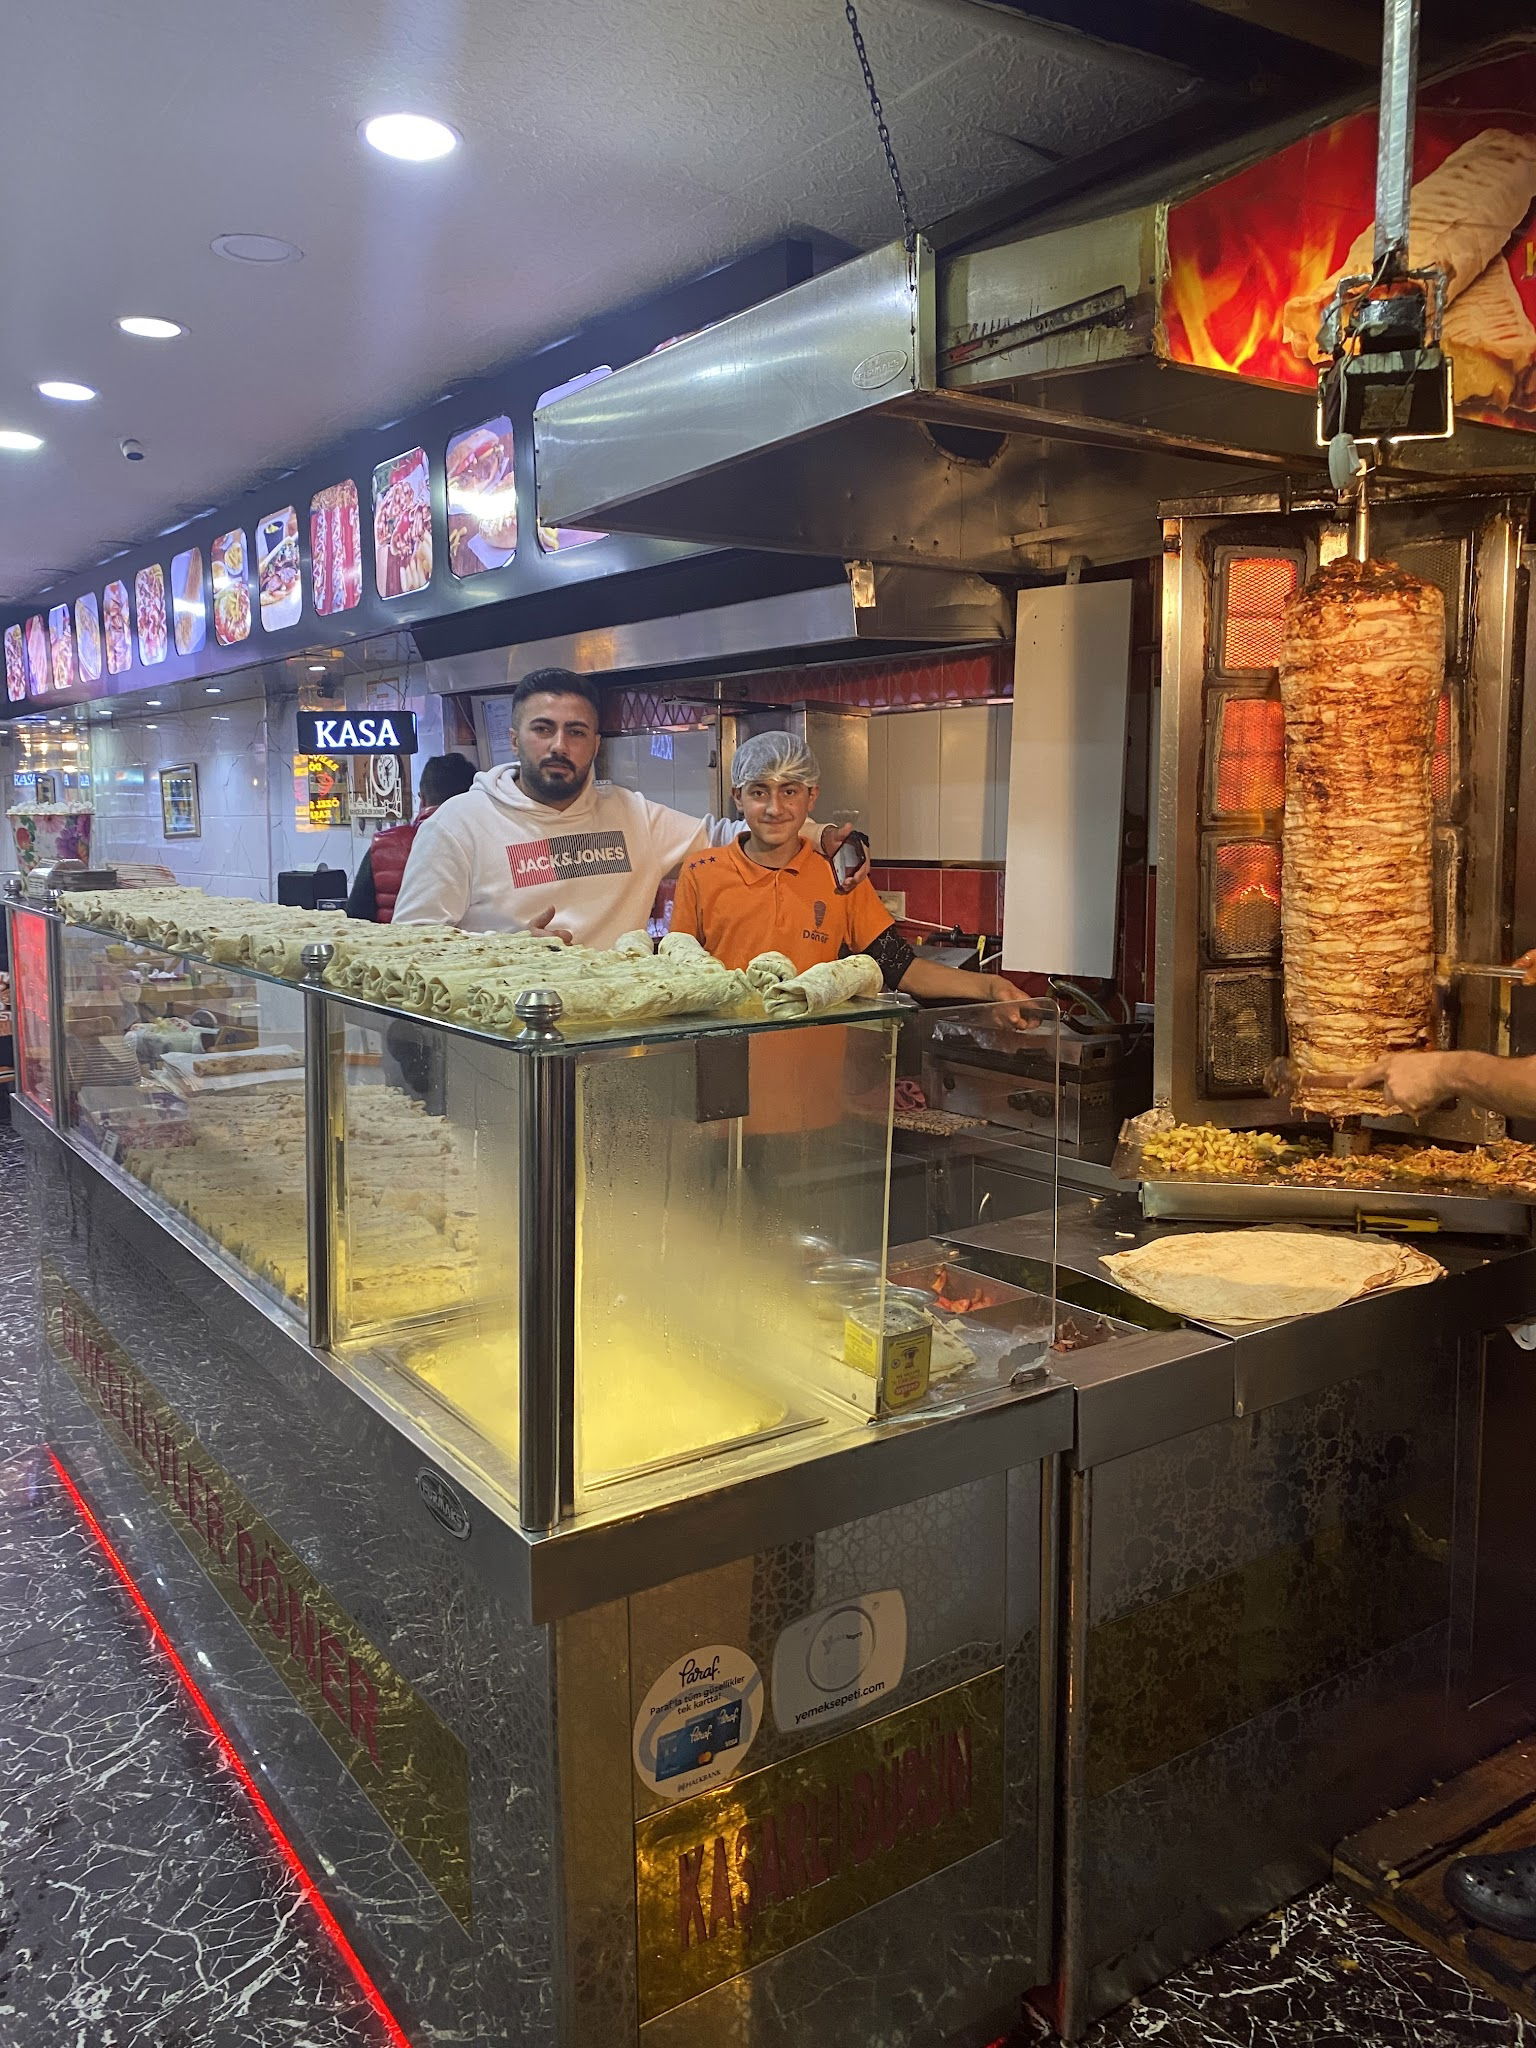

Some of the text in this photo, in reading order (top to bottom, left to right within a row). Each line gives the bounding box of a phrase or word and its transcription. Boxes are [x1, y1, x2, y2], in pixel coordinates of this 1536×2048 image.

[314, 718, 400, 748] KASA
[517, 846, 625, 874] JACK&JONES
[236, 1519, 384, 1775] DÖNER
[685, 1692, 702, 1705] tüm
[703, 1676, 745, 1698] güzellikler
[794, 1681, 885, 1724] yemeksepeti.com
[678, 1703, 691, 1715] tek
